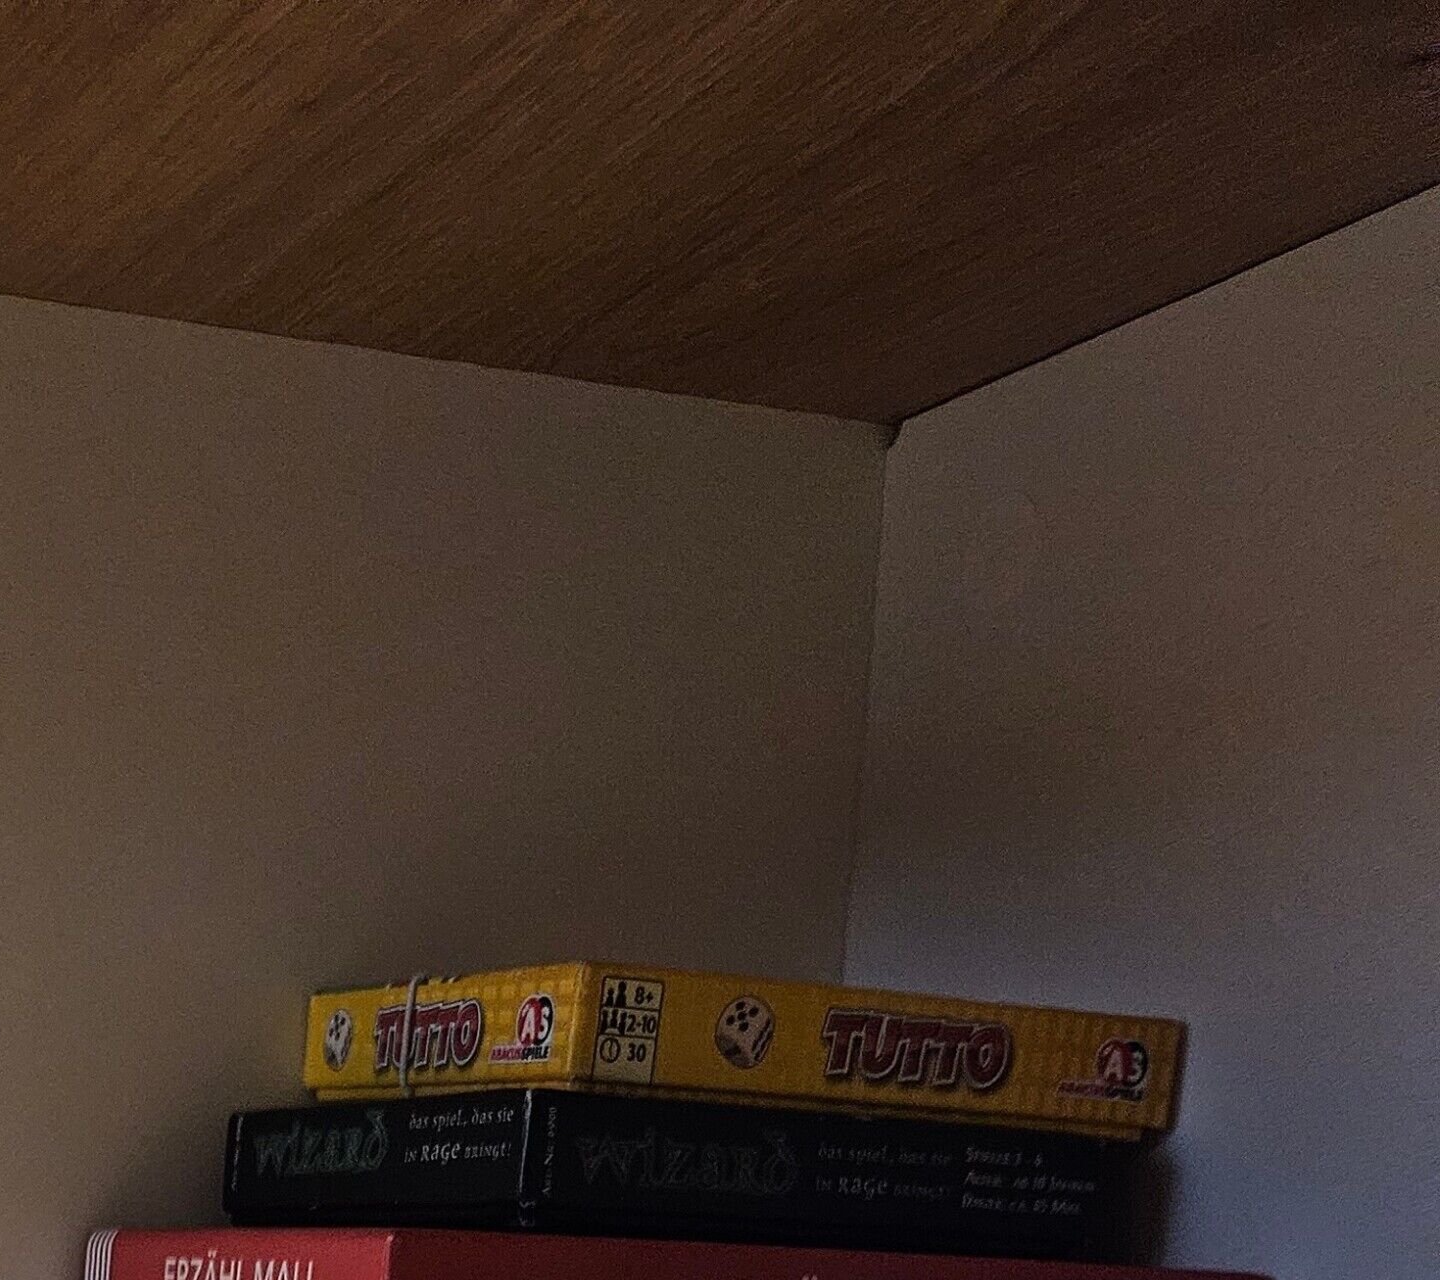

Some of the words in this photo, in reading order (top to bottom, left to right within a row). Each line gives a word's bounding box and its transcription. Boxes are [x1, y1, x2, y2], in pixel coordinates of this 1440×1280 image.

[635, 986, 654, 1005] 8+
[626, 1014, 657, 1034] 2-10
[374, 998, 486, 1074] TUTTO
[626, 1042, 647, 1062] 30
[822, 1008, 1012, 1090] TUTTO
